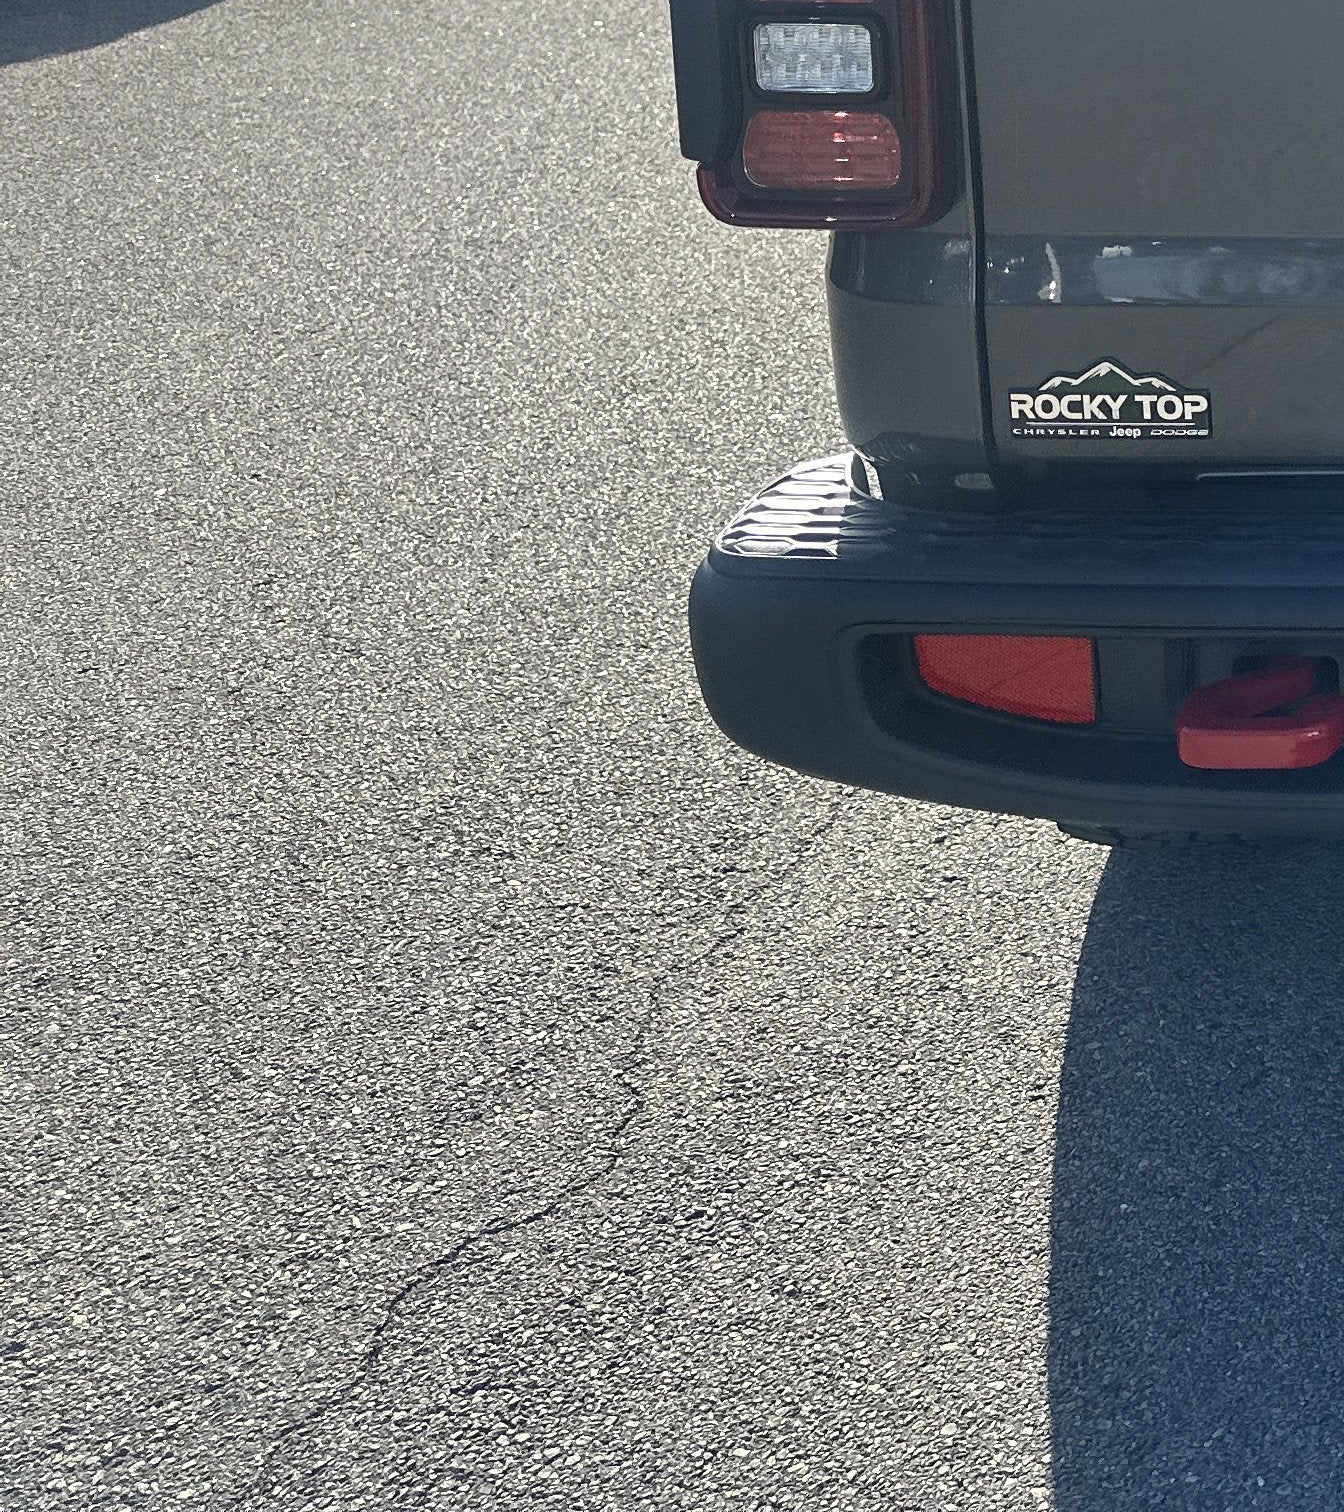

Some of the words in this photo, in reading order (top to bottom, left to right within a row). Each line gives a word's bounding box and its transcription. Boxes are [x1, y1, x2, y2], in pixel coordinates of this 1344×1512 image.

[1009, 393, 1128, 420] ROCKY
[1134, 394, 1208, 420] TOP
[1012, 428, 1100, 436] CHRYSLER
[1109, 426, 1142, 438] Jeep
